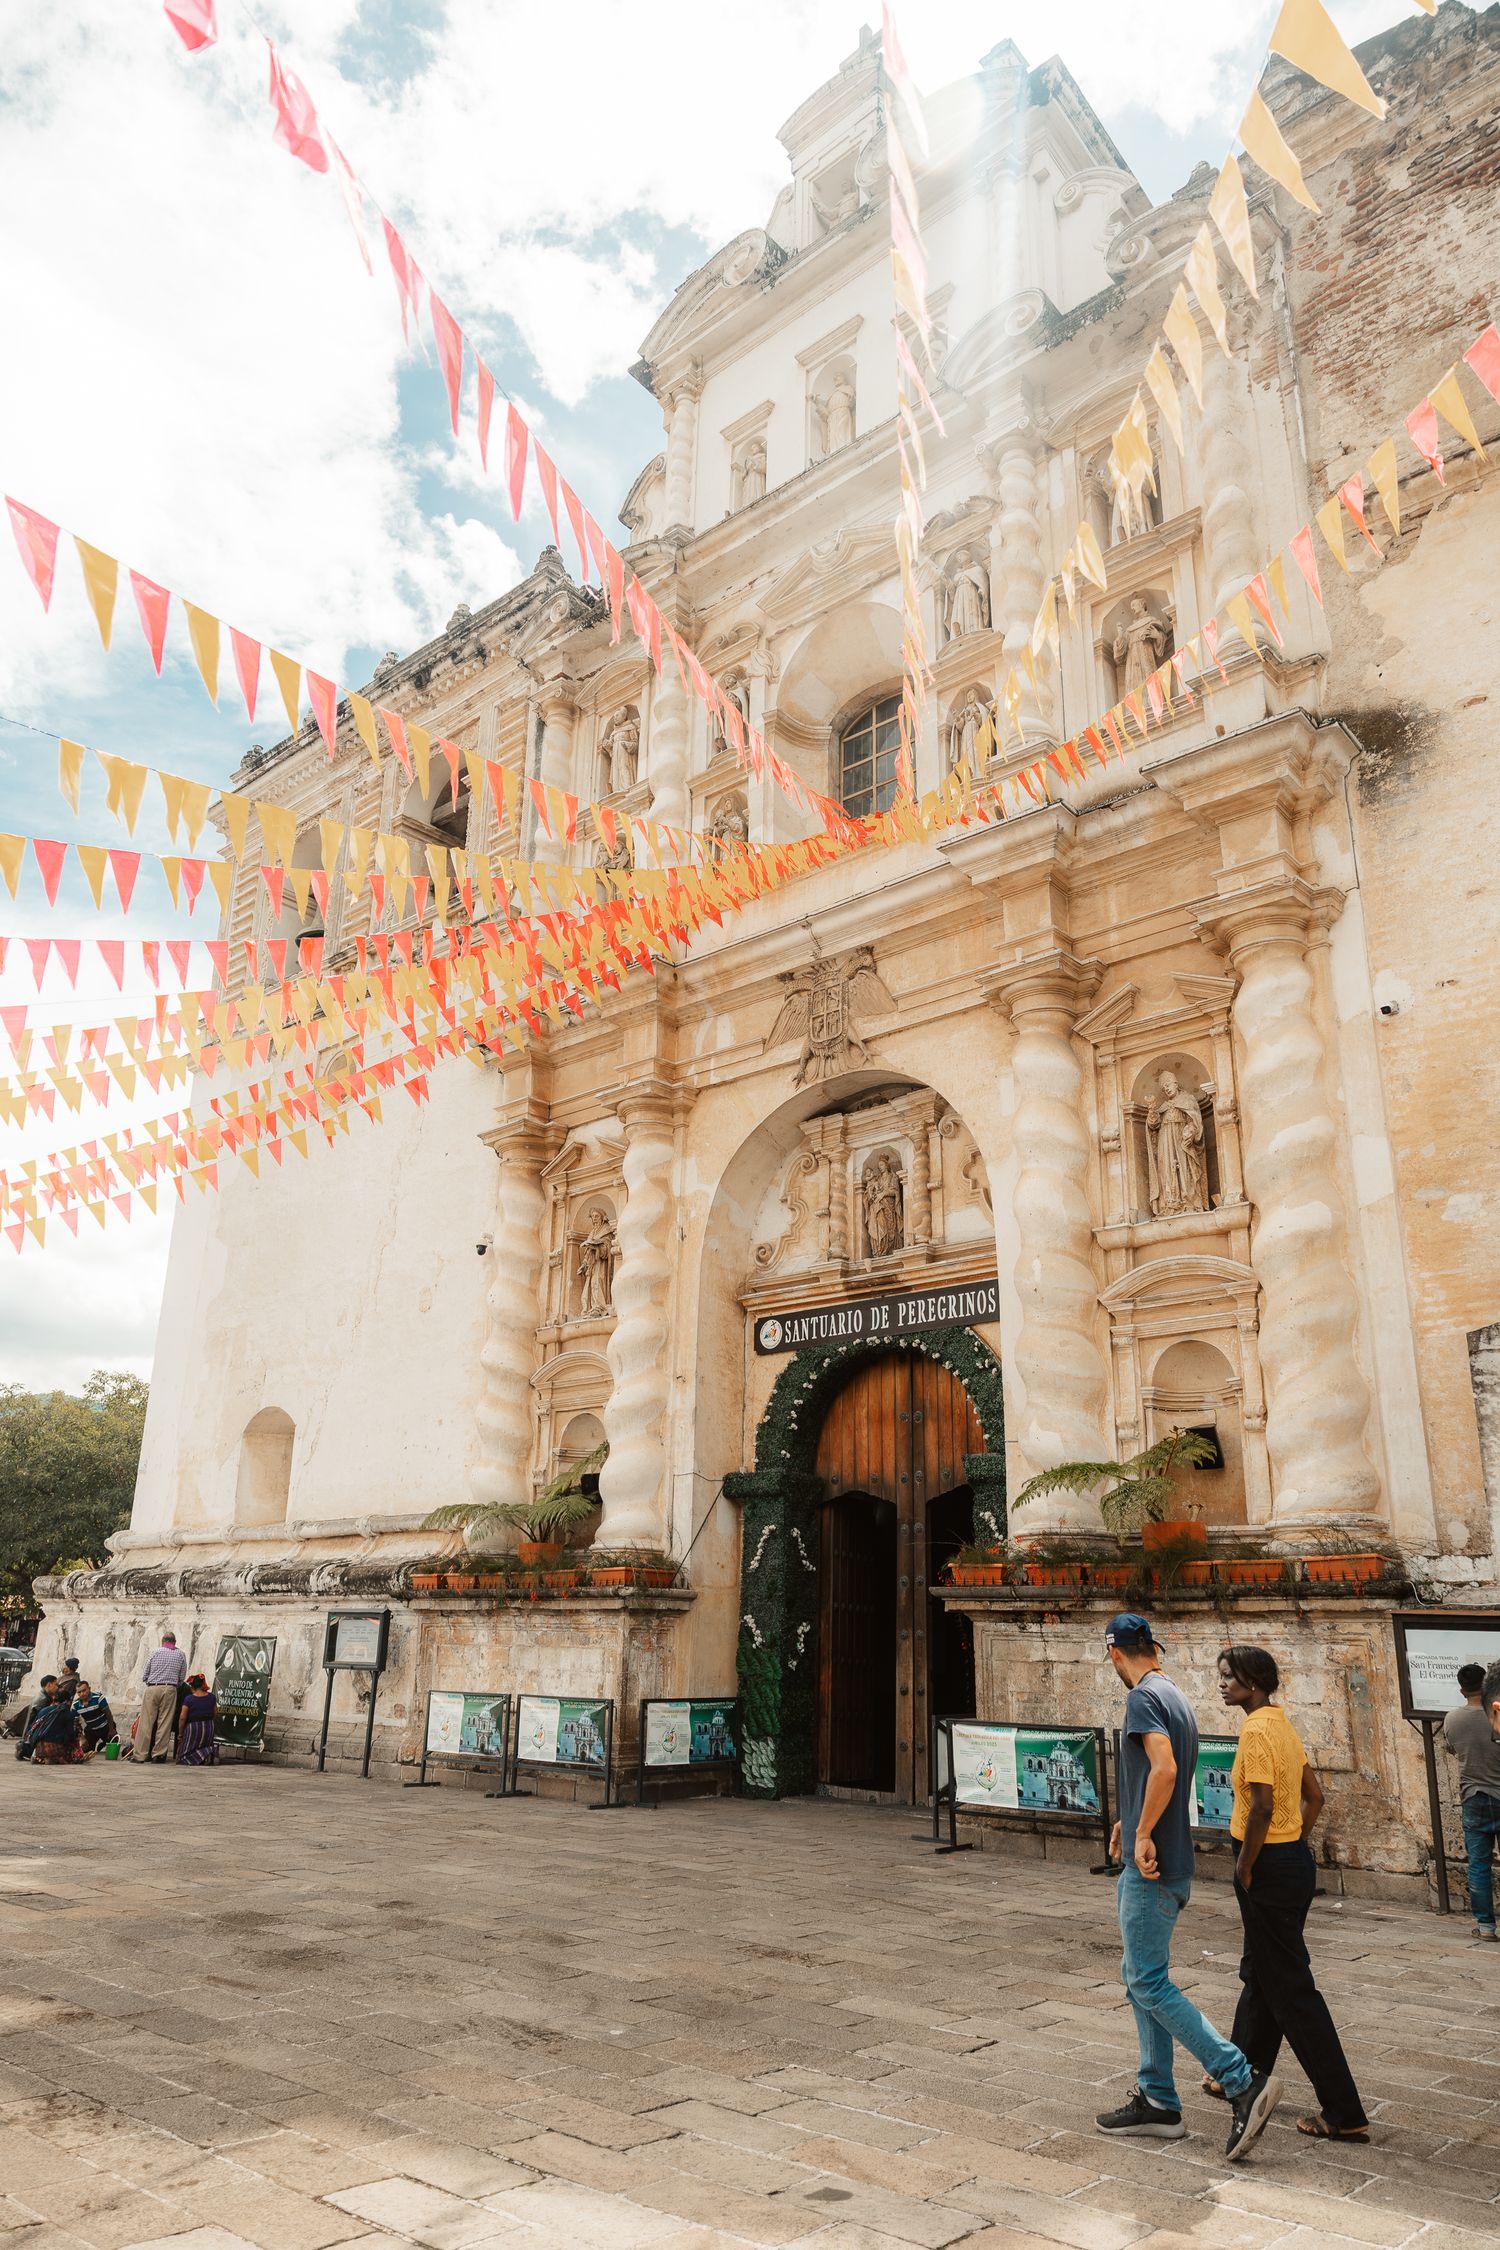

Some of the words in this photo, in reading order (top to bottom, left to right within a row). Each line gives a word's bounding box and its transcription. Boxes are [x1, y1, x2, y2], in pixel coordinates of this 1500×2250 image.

[784, 1309, 863, 1343] SANTUARIO
[870, 1305, 890, 1331] DE
[897, 1287, 997, 1327] PEREGRINOS
[1410, 1660, 1426, 1669] San
[1420, 1670, 1427, 1679] El
[228, 1680, 246, 1689] PUNTO
[246, 1680, 253, 1690] DE
[224, 1688, 254, 1698] ENCUENTRO
[218, 1697, 230, 1706] PARA
[230, 1698, 250, 1707] GRUPOS
[250, 1699, 258, 1708] DE
